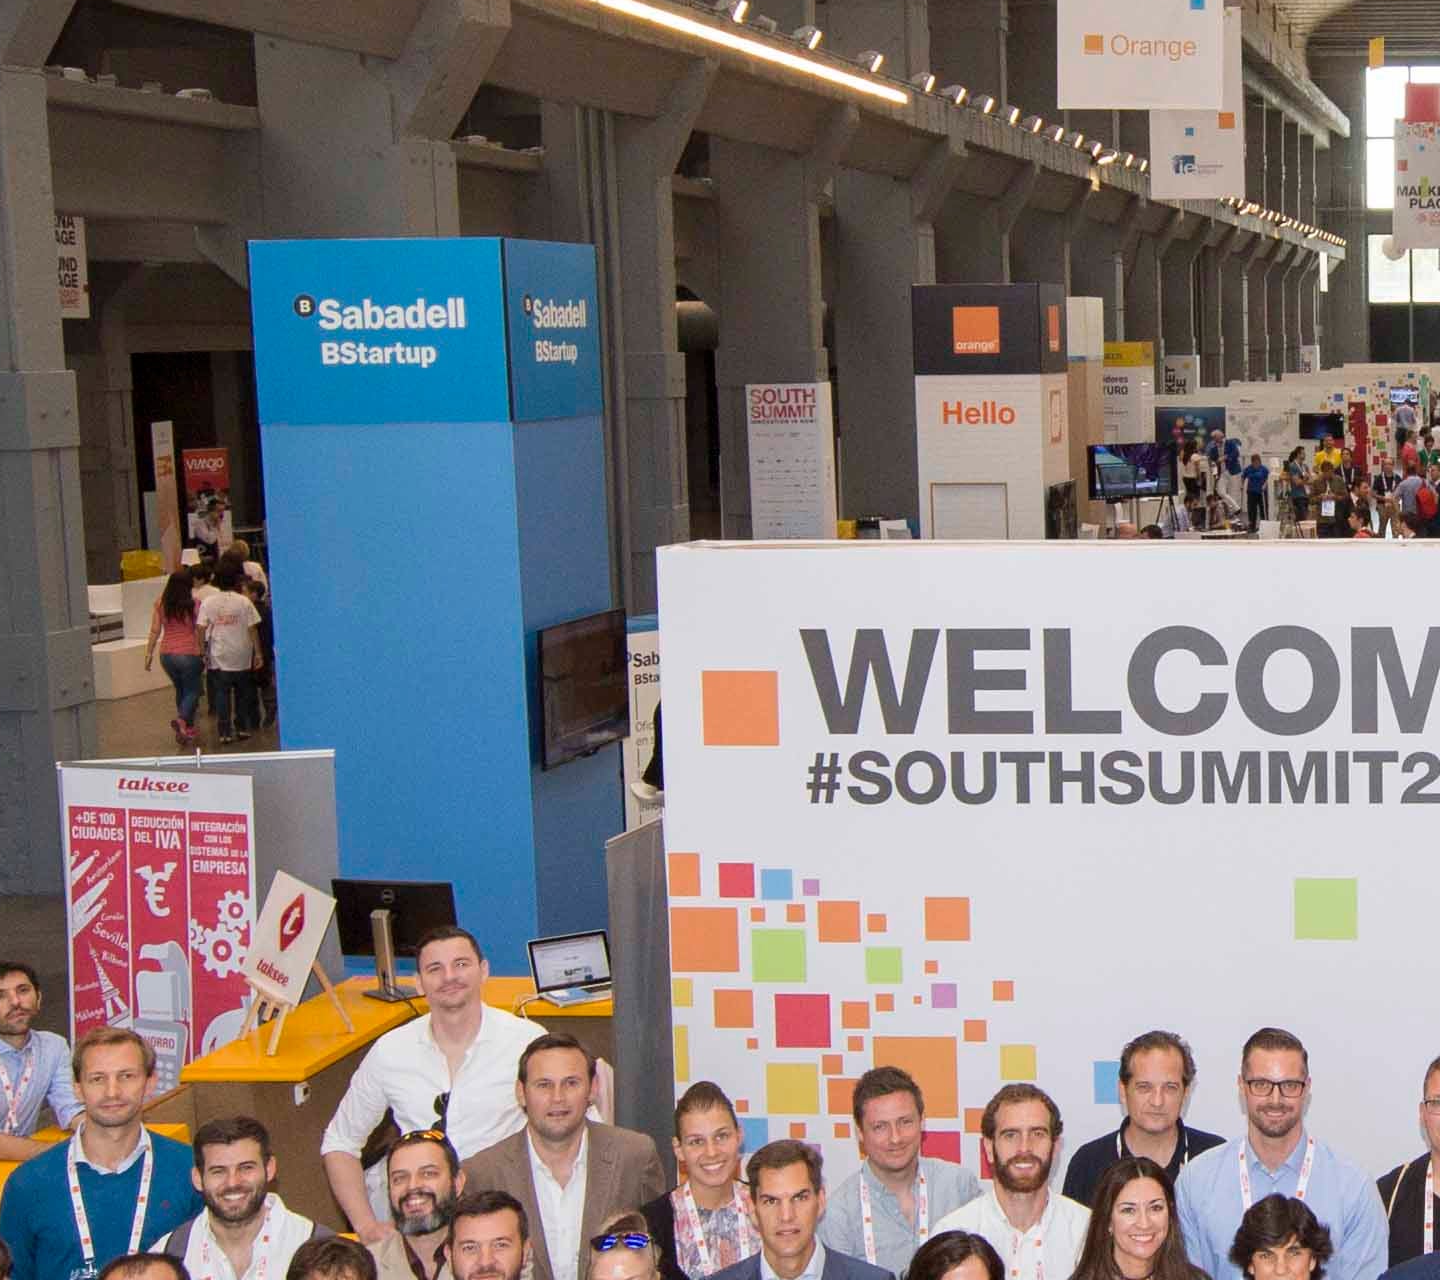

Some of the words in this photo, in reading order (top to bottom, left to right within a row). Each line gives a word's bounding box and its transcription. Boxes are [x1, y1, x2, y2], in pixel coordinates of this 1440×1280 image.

[1110, 35, 1197, 62] Orange
[319, 297, 465, 330] Sabadell
[533, 298, 586, 329] Sabadell
[321, 342, 437, 368] BStartup
[536, 340, 578, 364] BStartup
[955, 340, 995, 351] orange
[751, 388, 816, 404] SOUTH
[751, 405, 816, 419] SUMMIT
[942, 400, 1016, 425] Hello
[118, 776, 190, 793] taksee
[99, 813, 116, 825] 100
[72, 826, 125, 841] CIUDADES
[135, 830, 153, 843] DEL
[155, 830, 181, 850] IVA
[193, 859, 246, 875] EMPRESA
[92, 923, 129, 951] Sevilla
[257, 959, 289, 987] taksee
